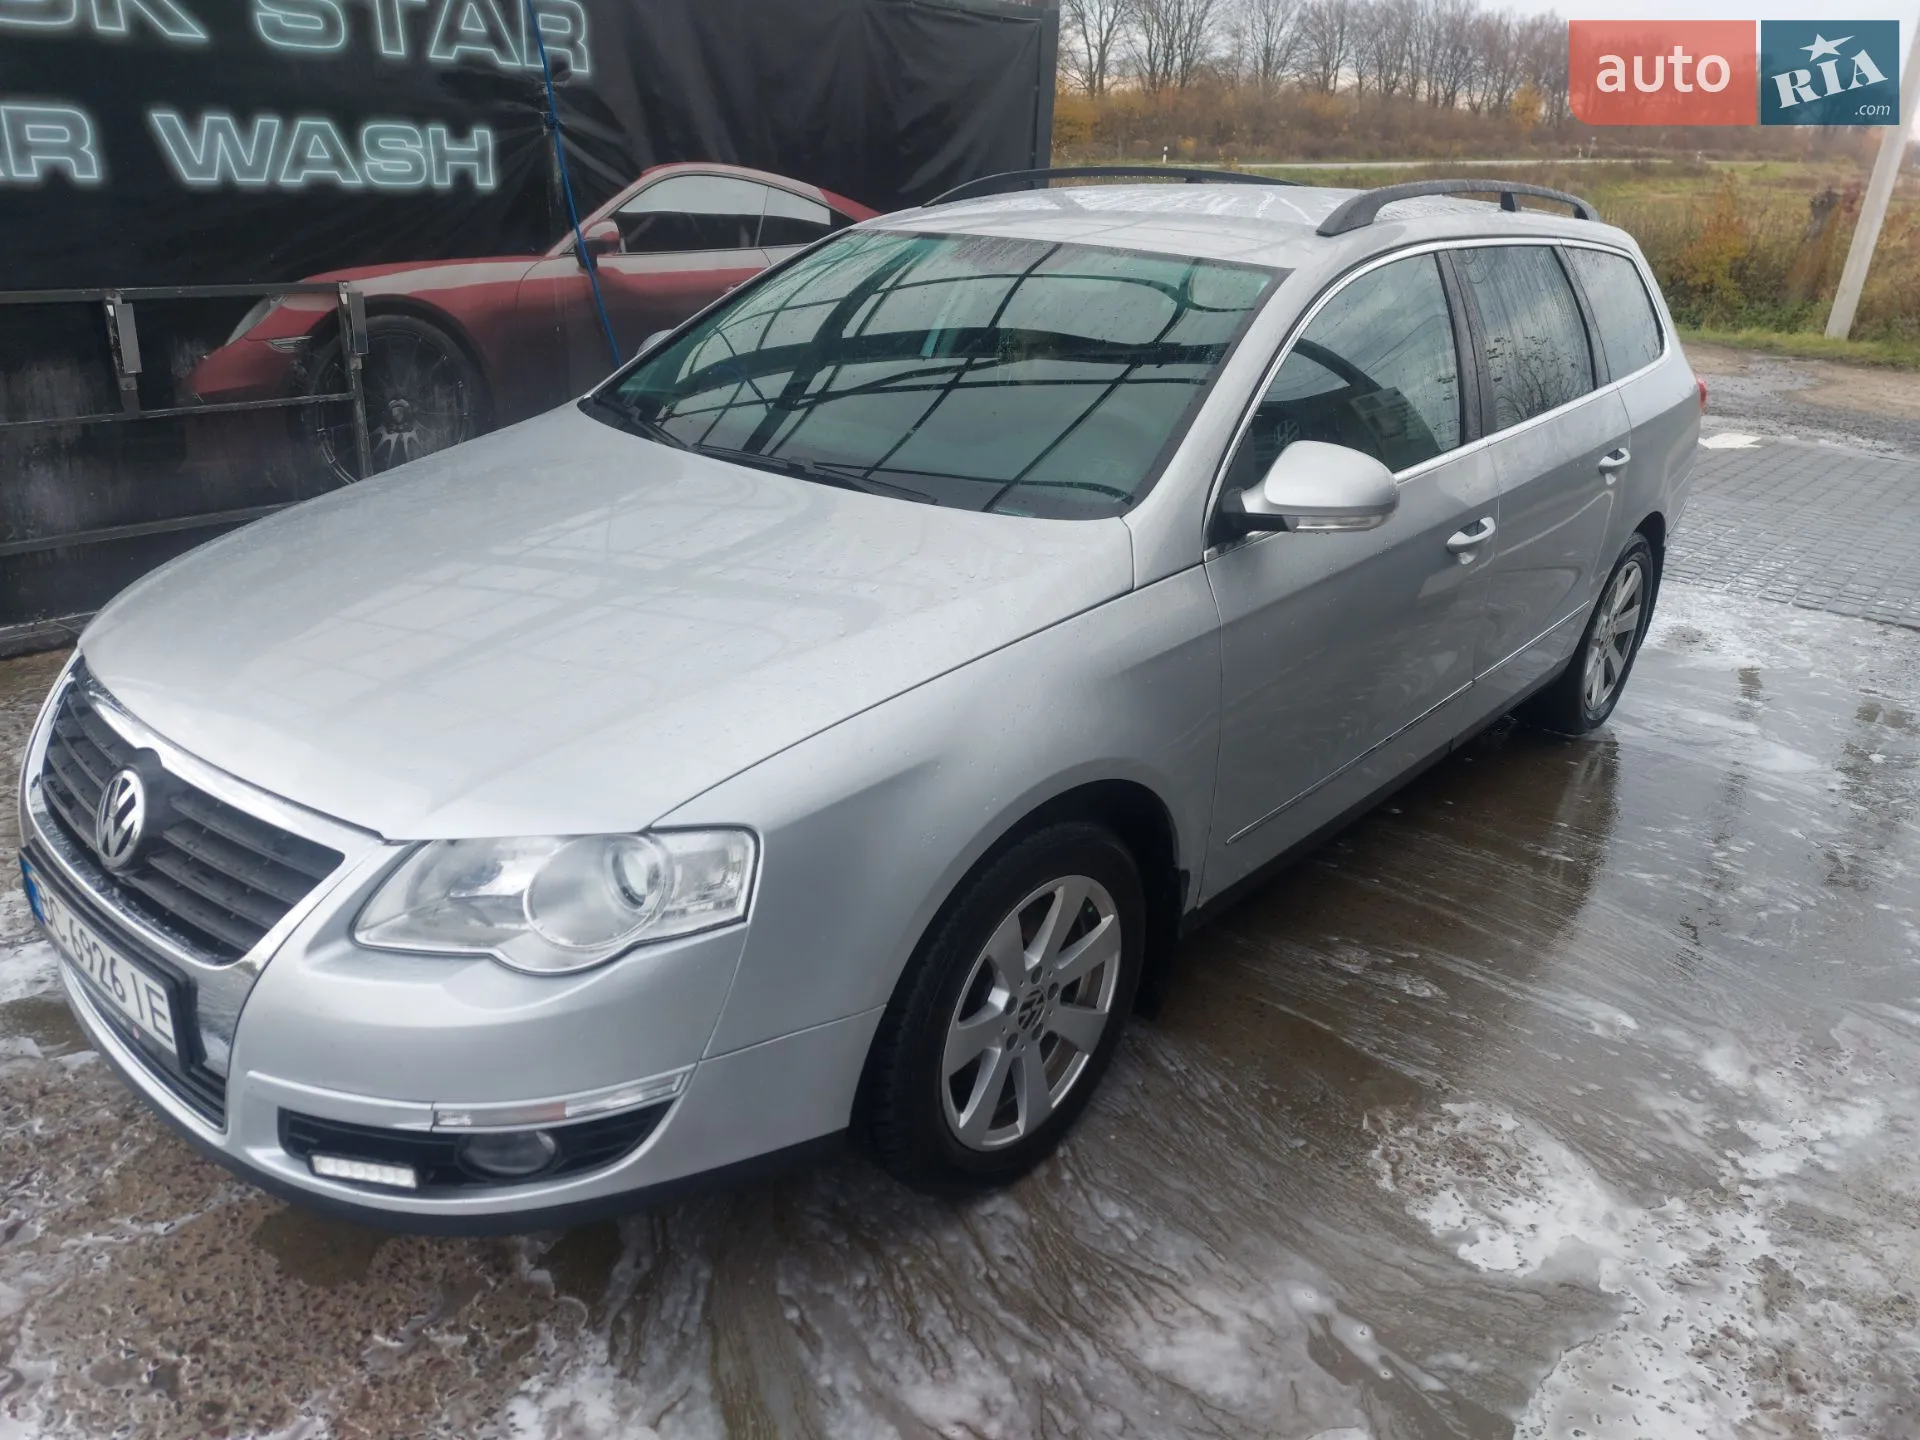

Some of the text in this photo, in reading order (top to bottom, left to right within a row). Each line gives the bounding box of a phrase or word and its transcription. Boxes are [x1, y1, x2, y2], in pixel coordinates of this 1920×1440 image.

[255, 0, 590, 73] STAR
[0, 105, 496, 187] R WASH
